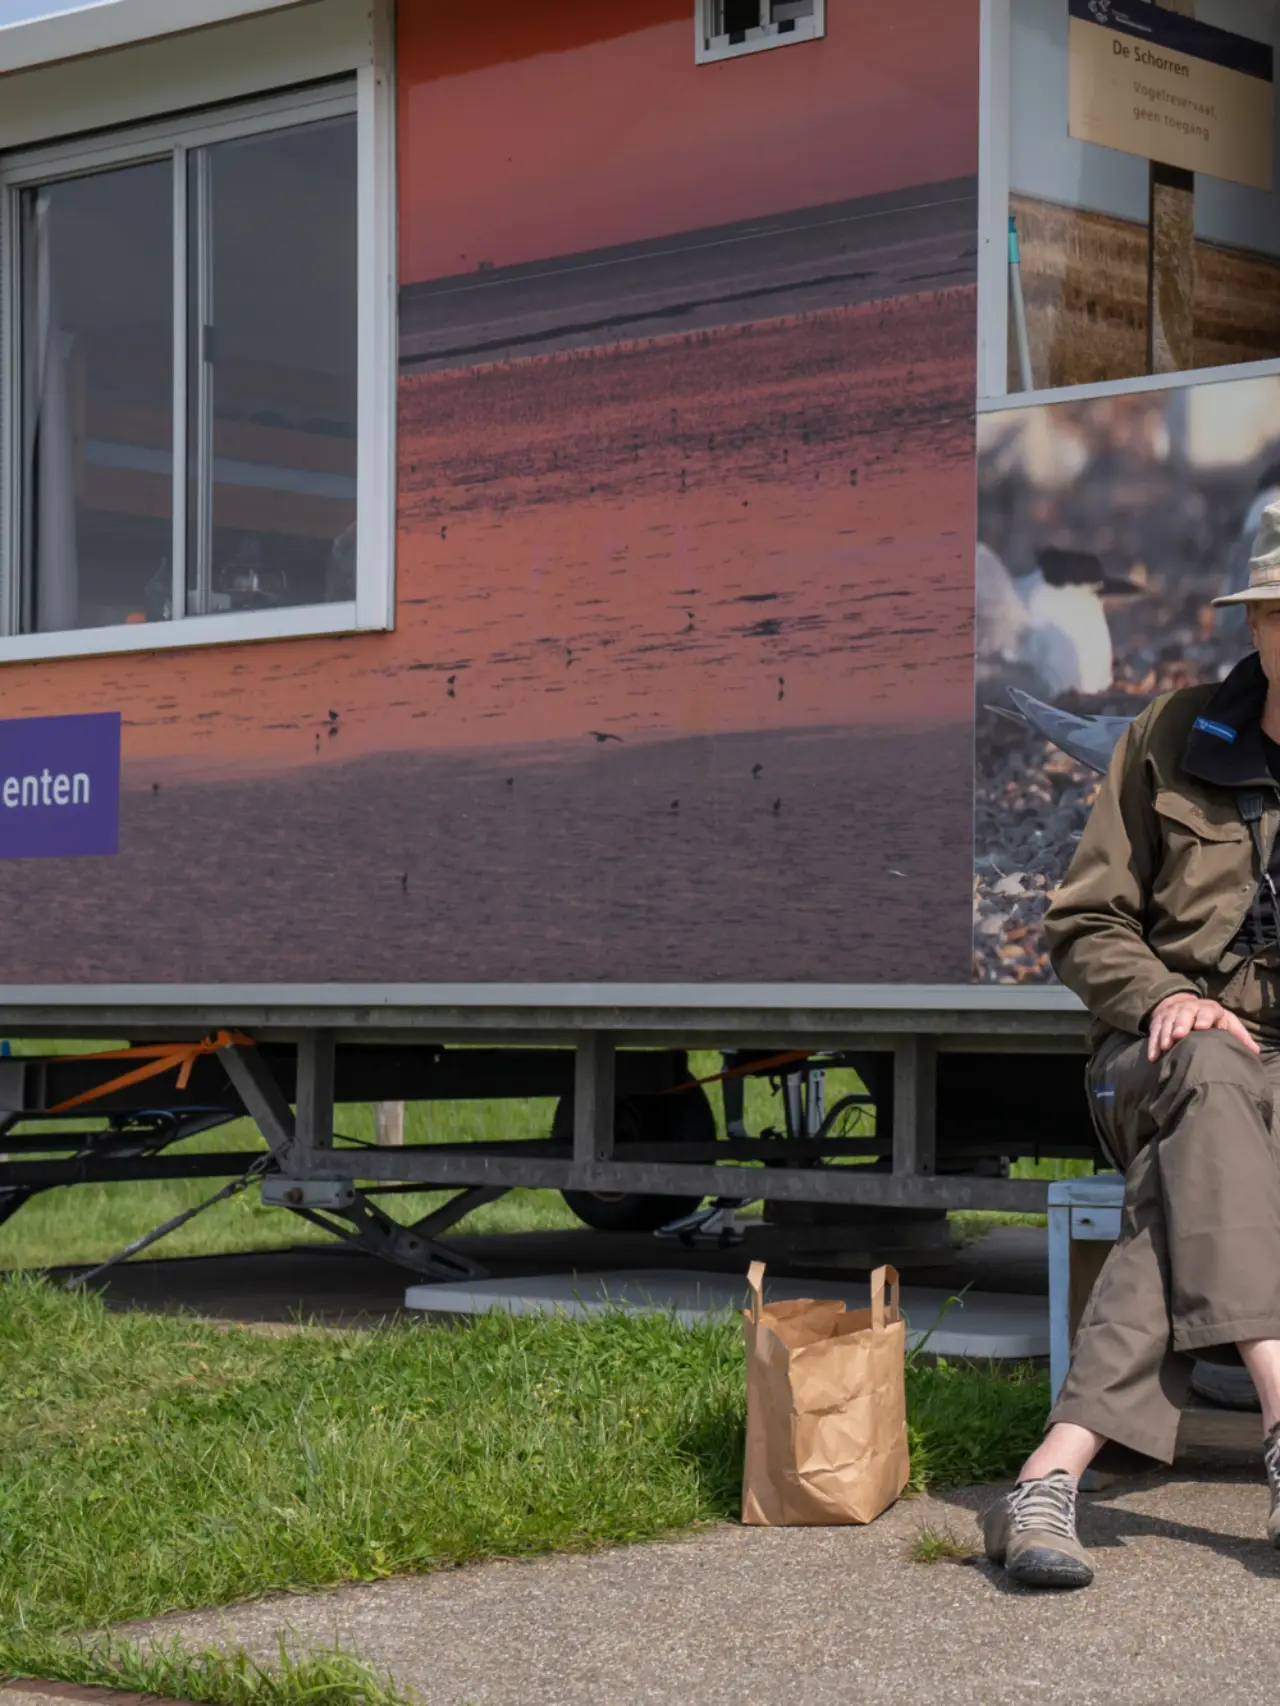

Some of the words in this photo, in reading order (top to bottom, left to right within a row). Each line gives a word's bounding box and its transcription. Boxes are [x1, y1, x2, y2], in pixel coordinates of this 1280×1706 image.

[1112, 39, 1130, 58] De
[1134, 45, 1189, 77] Schorren
[1133, 106, 1161, 121] geen
[1164, 114, 1210, 142] toegang
